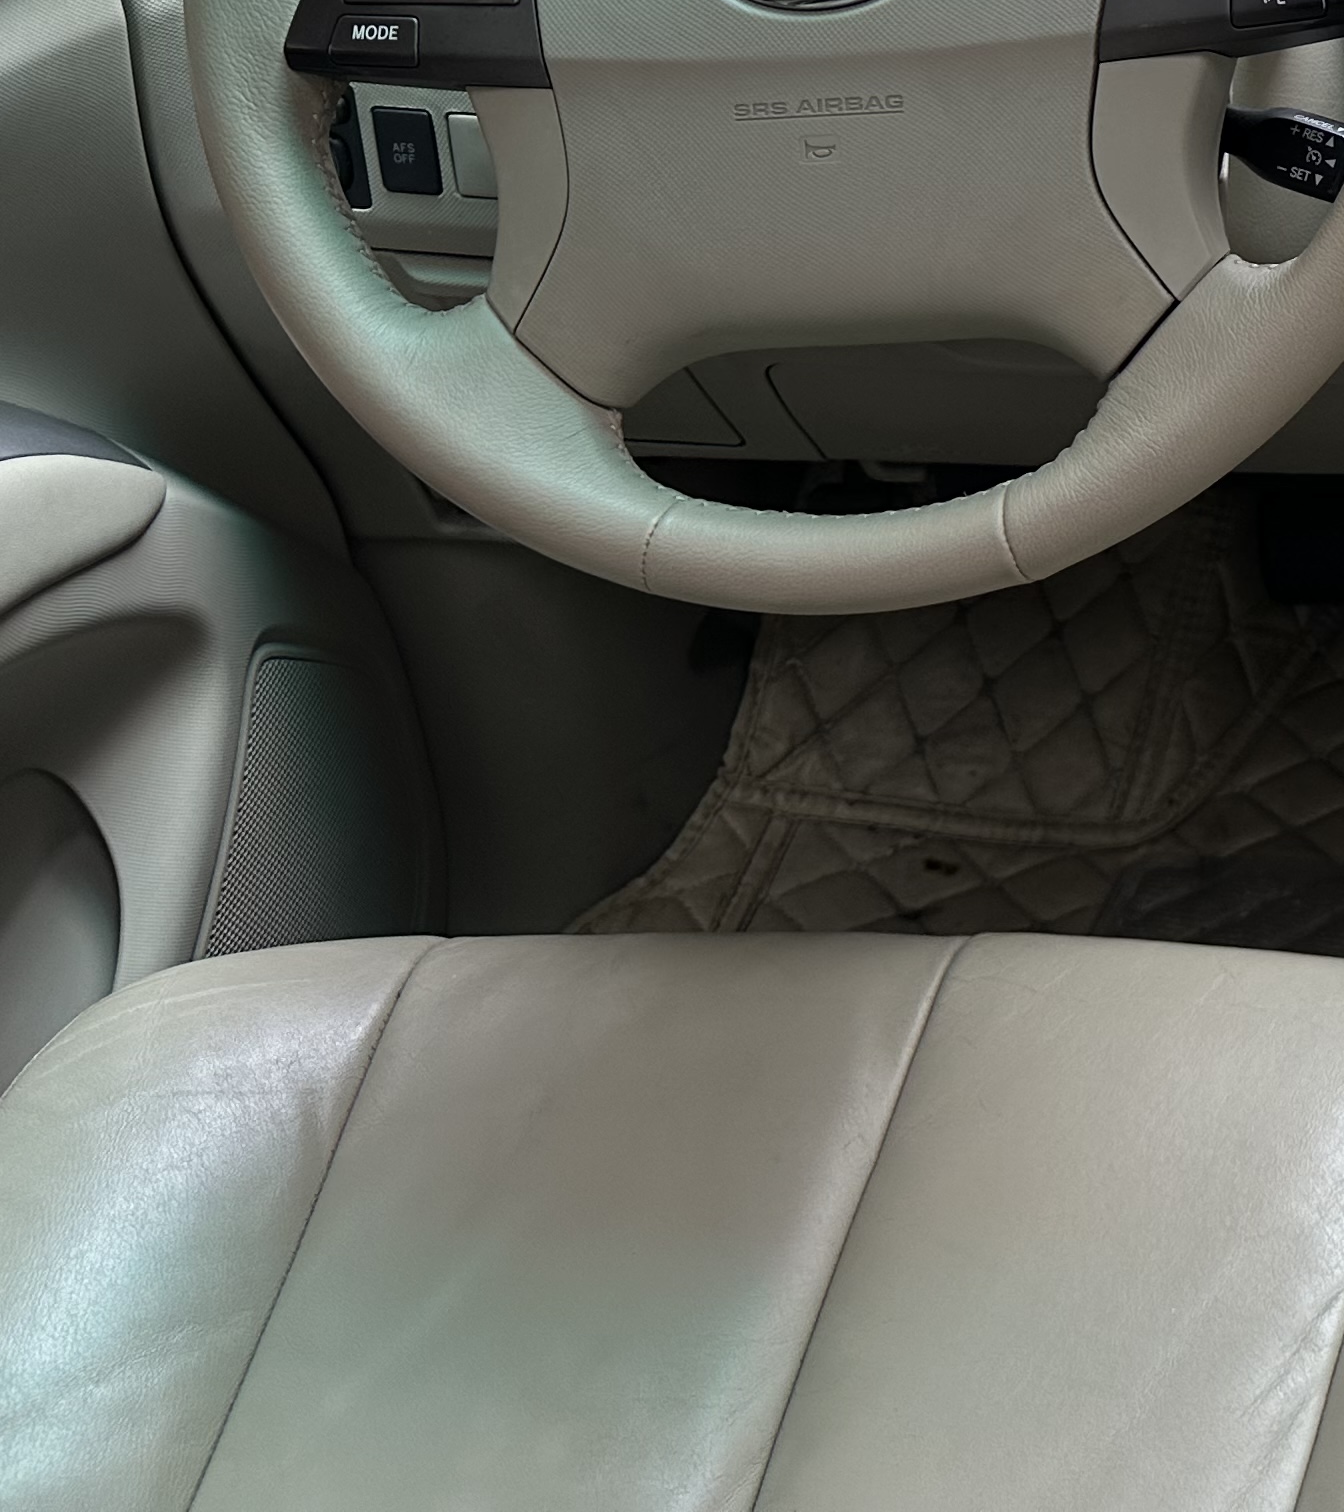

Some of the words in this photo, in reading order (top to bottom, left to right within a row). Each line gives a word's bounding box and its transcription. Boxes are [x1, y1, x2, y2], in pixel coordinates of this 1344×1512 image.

[351, 24, 399, 41] MODE
[733, 101, 789, 117] SRS
[795, 94, 905, 114] AIRBAG
[1293, 114, 1335, 131] CANCEL
[1302, 129, 1325, 144] RES
[392, 142, 416, 153] AFS
[393, 154, 416, 164] OFF
[1289, 166, 1312, 182] SET
